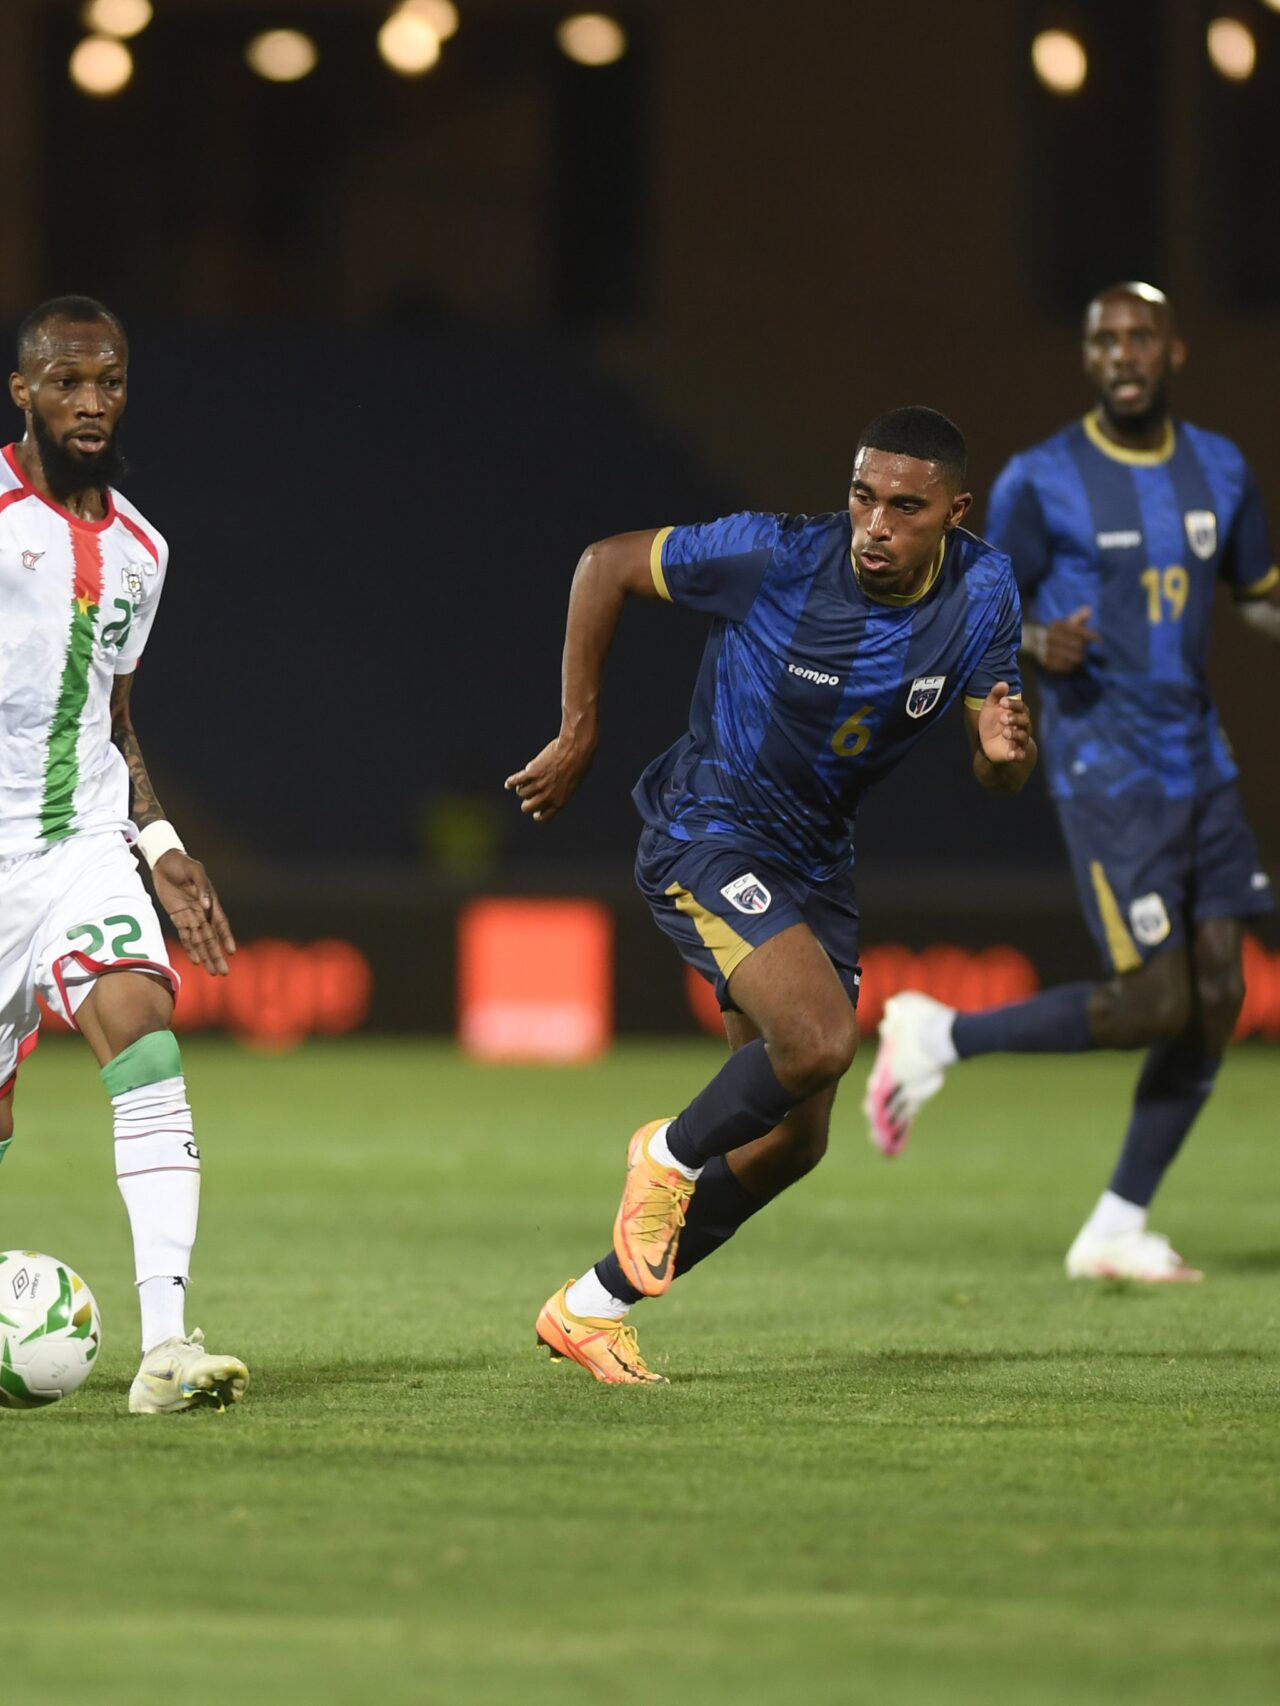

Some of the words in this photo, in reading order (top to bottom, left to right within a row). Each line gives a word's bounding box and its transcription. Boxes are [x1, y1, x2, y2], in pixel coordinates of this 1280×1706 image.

[1140, 564, 1189, 626] 19
[788, 663, 840, 686] tempo
[831, 706, 875, 756] 6
[67, 915, 150, 959] 22
